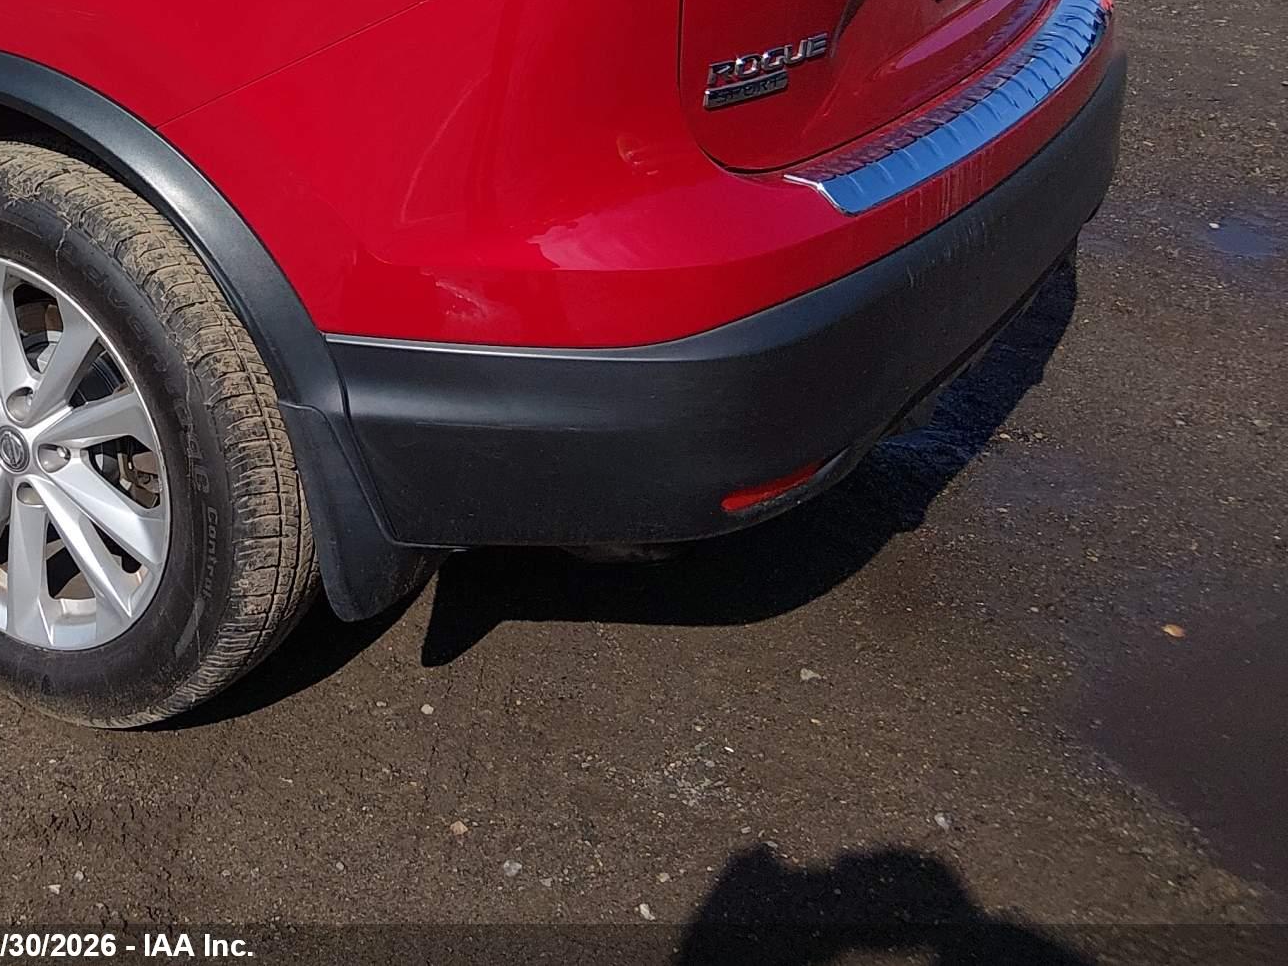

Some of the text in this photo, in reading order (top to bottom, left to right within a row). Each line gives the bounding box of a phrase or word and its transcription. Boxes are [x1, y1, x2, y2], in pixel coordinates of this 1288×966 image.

[707, 33, 829, 85] ROGUE
[707, 72, 785, 105] SPORT
[201, 506, 219, 601] Control
